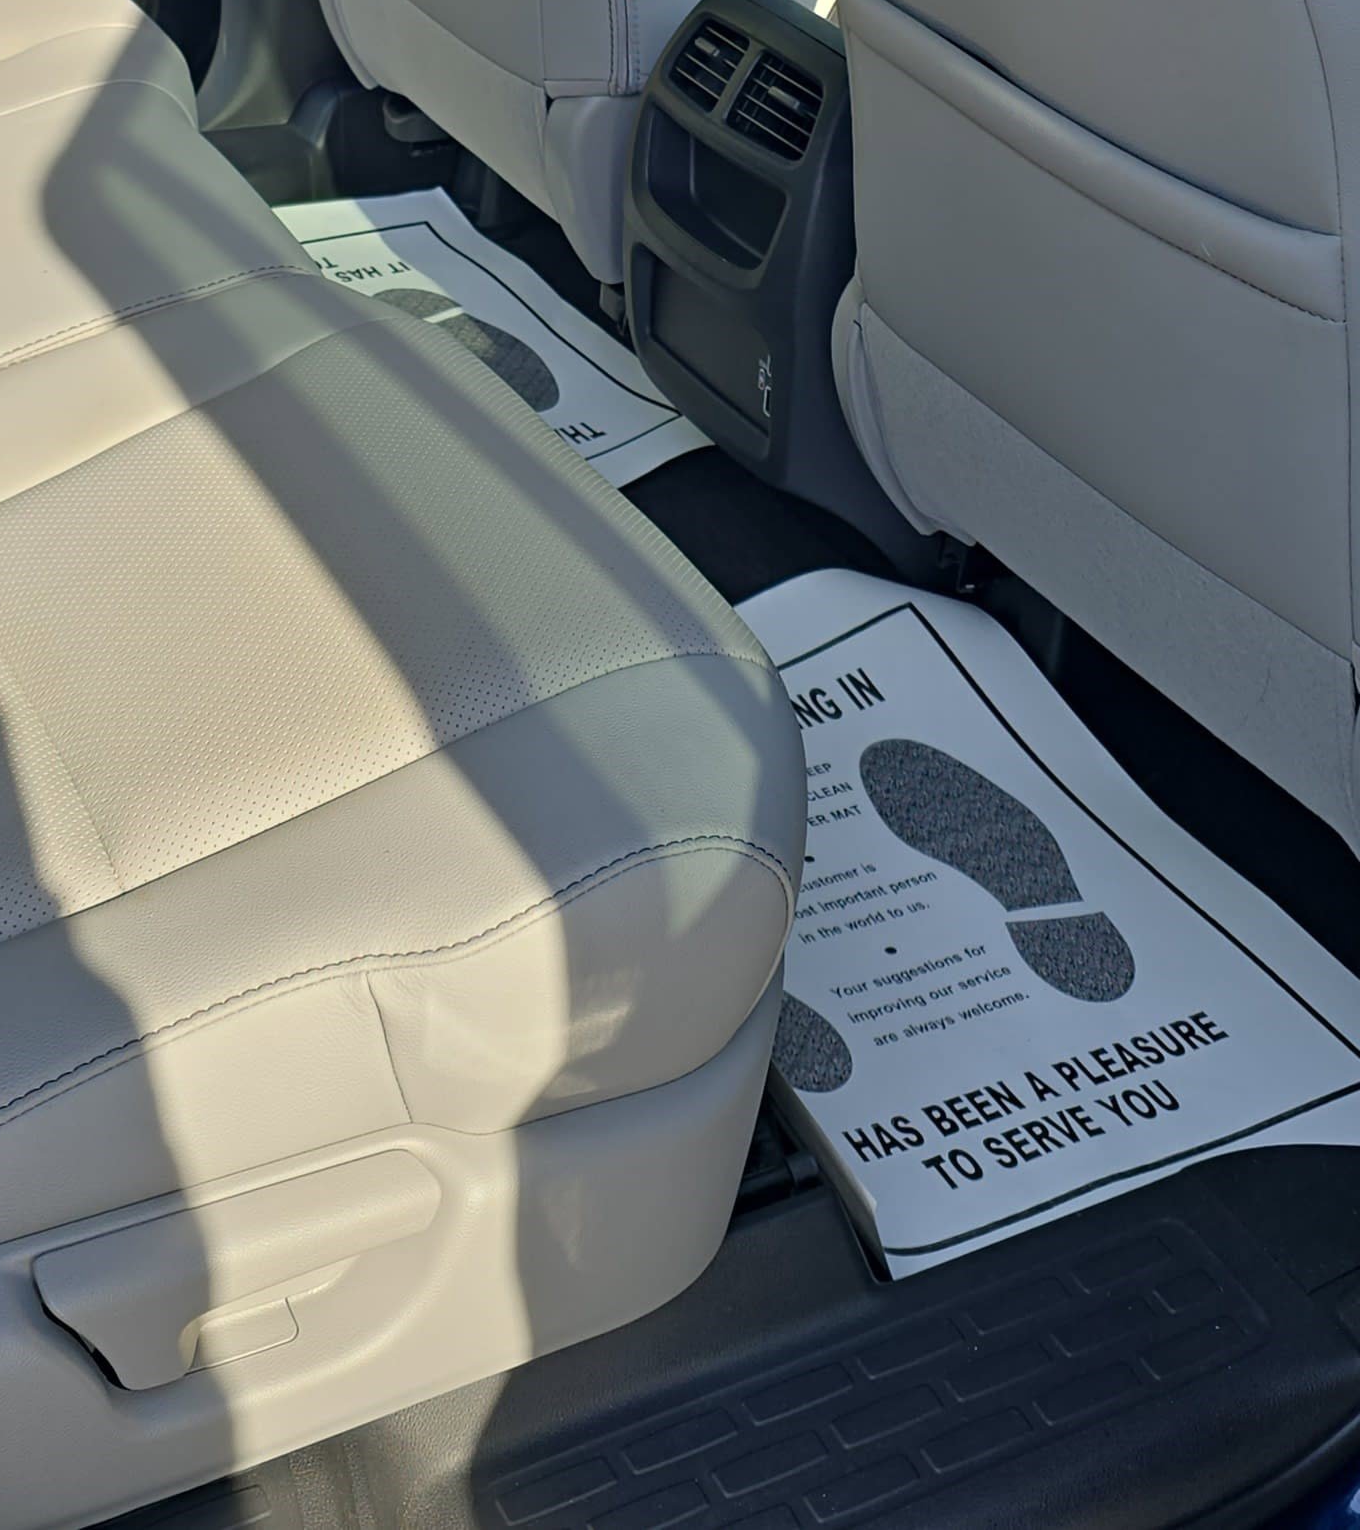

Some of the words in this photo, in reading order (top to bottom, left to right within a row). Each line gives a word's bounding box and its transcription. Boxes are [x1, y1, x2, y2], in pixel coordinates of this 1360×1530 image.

[315, 257, 339, 270] T
[334, 265, 383, 283] HAS
[387, 261, 411, 274] IT
[789, 687, 843, 730] NG
[836, 667, 886, 711] IN
[805, 762, 832, 777] EEP
[806, 781, 854, 802] CLEAN
[805, 814, 831, 827] ER
[829, 804, 862, 822] MAT
[859, 862, 877, 874] is
[794, 904, 819, 920] ost
[818, 885, 888, 913] important
[889, 870, 938, 895] person
[798, 932, 817, 945] in
[817, 925, 843, 940] the
[845, 910, 886, 932] world
[886, 907, 904, 920] to
[829, 981, 869, 999] Your
[872, 951, 964, 989] suggestions
[963, 943, 988, 959] for
[847, 993, 928, 1024] improving
[928, 983, 955, 1001] our
[957, 965, 1013, 991] service
[873, 1031, 900, 1047] are
[902, 1014, 957, 1039] always
[958, 991, 1031, 1021] welcome.
[841, 1114, 926, 1163] HAS
[920, 1080, 1027, 1138] BEEN
[1023, 1070, 1062, 1102] A
[1051, 1011, 1230, 1092] PLEASURE
[921, 1148, 985, 1190] TO
[982, 1104, 1107, 1169] SERVE
[1094, 1078, 1181, 1127] YOU
